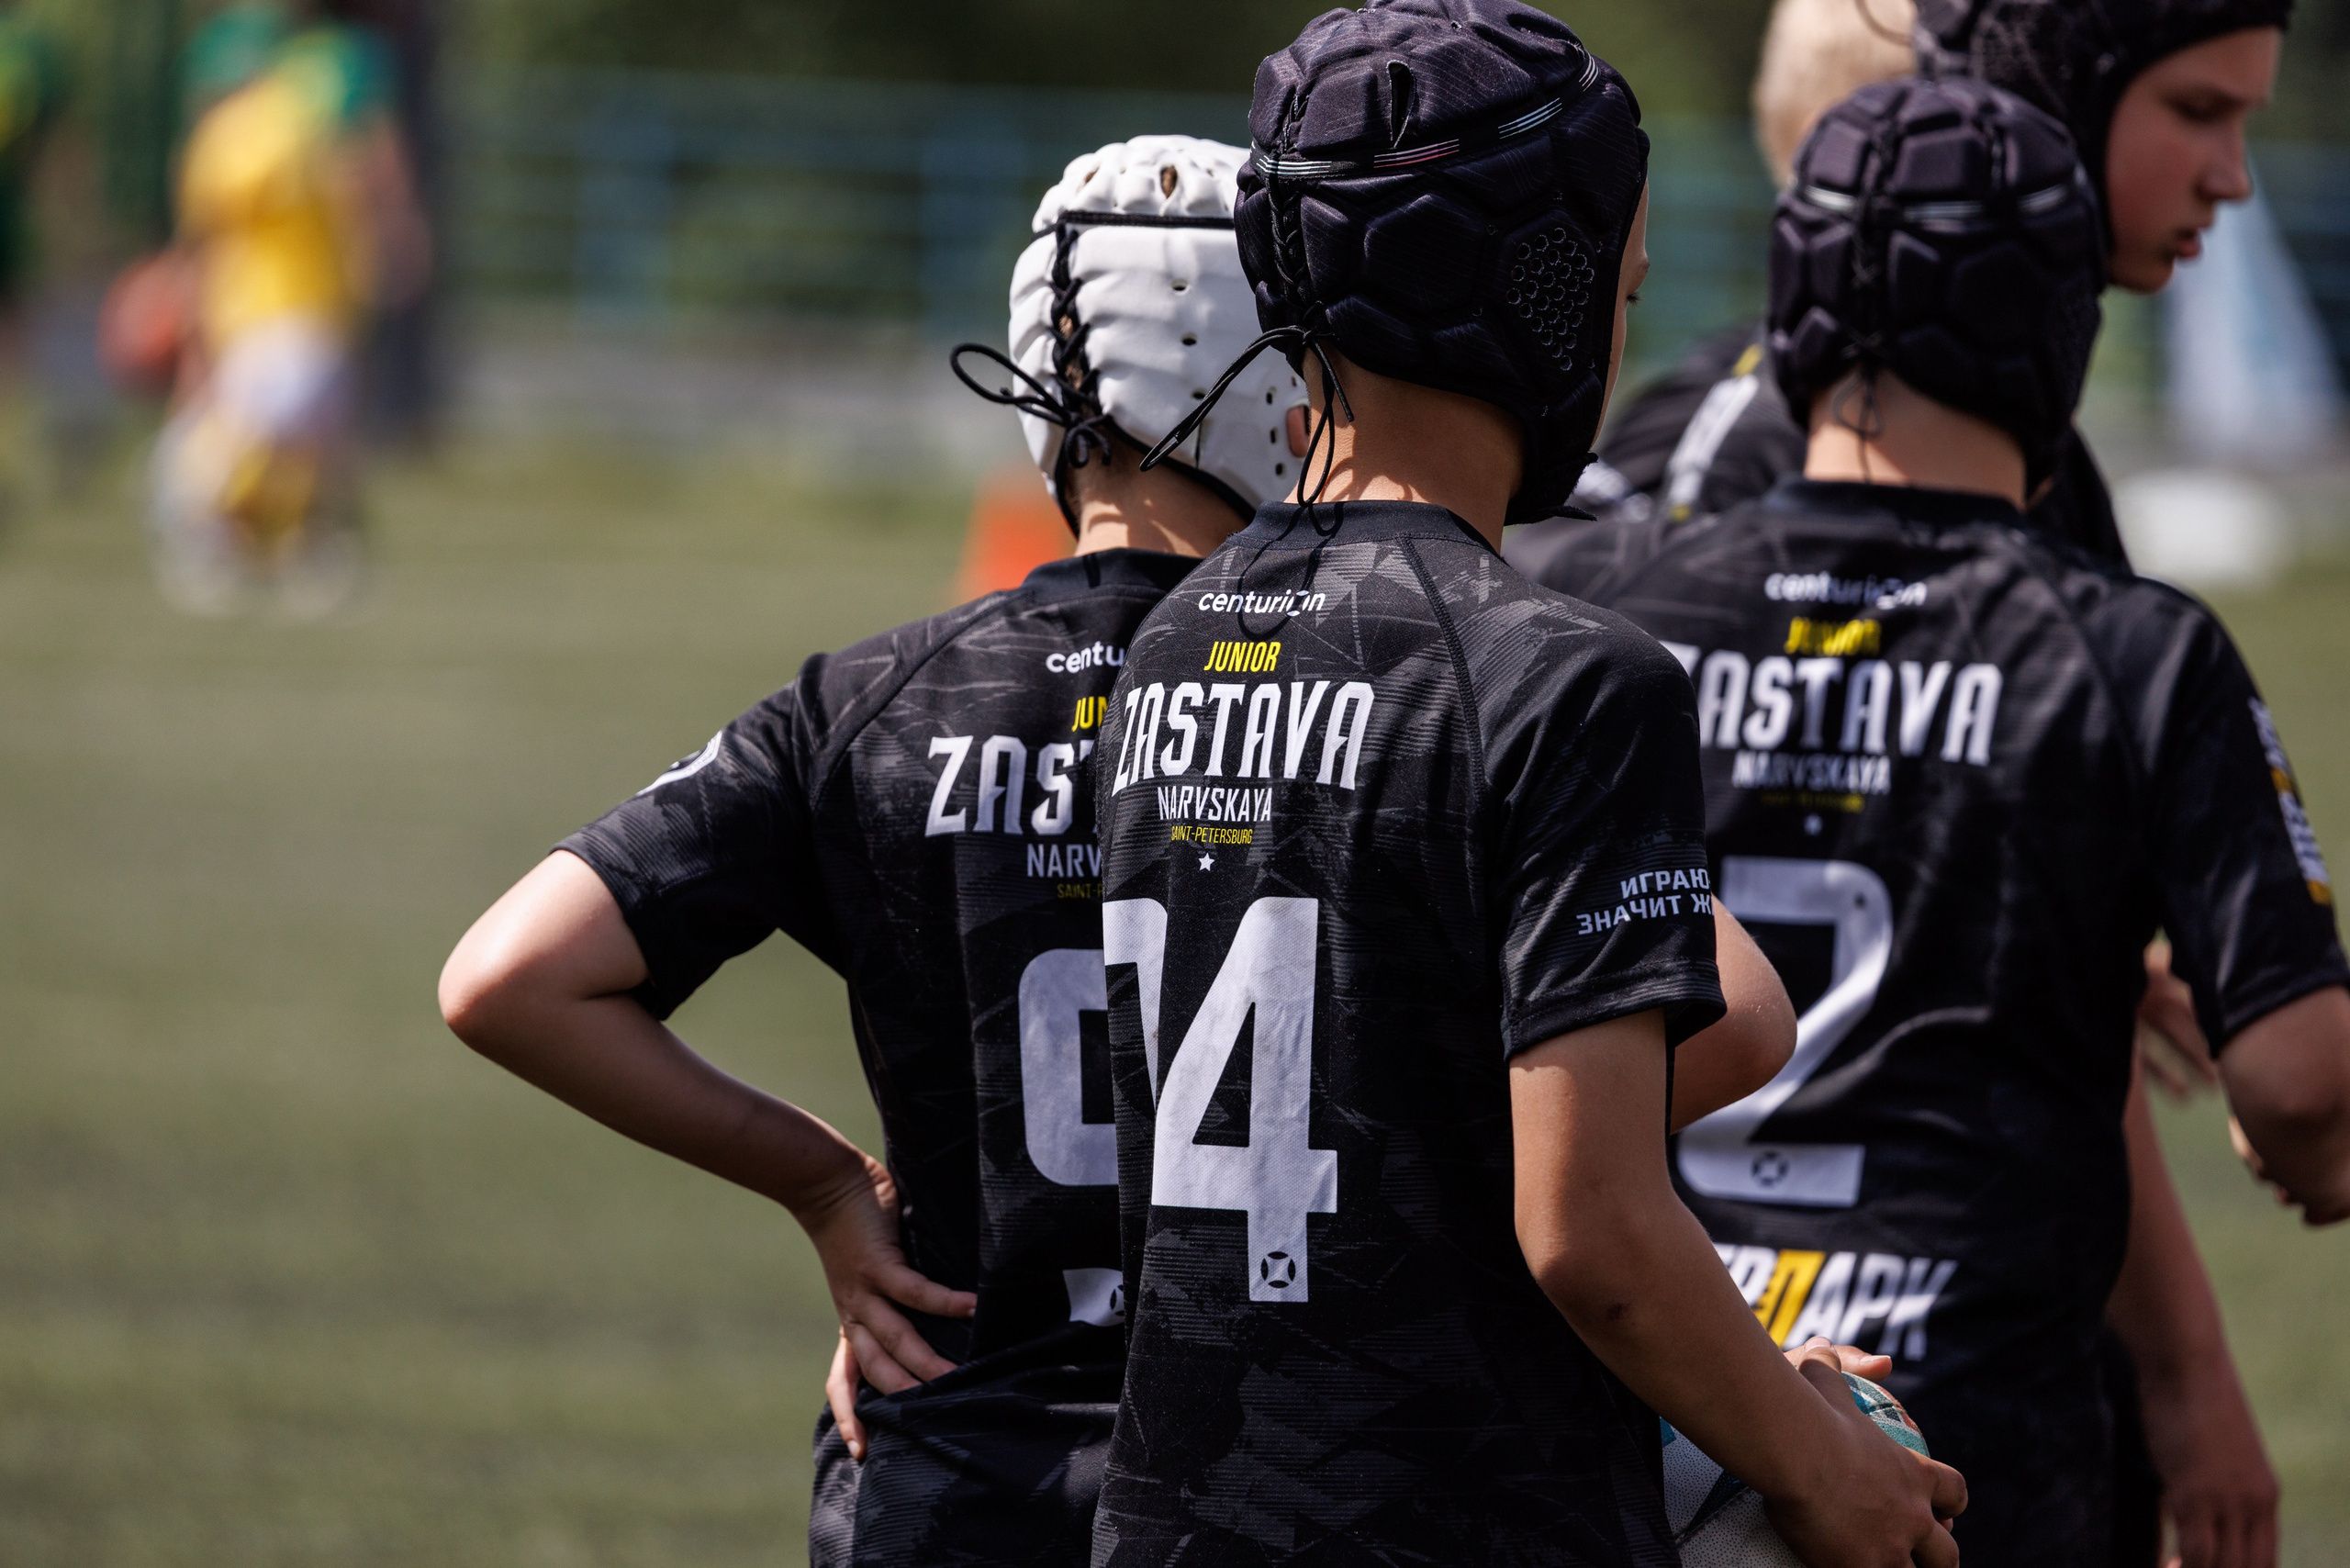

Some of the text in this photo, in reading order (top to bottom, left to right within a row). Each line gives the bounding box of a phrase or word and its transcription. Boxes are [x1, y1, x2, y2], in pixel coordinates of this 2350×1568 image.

[1046, 641, 1125, 673] centu
[1203, 641, 1281, 672] JUNIOR
[1111, 680, 1375, 797] ZASTAVA
[1157, 785, 1272, 823] NARVSKAYA
[1170, 825, 1253, 845] SAINT-PETERSBURG
[1026, 844, 1102, 878] NARV
[1575, 894, 1682, 935] ЗНАЧИТ
[1677, 855, 1894, 1209] 2
